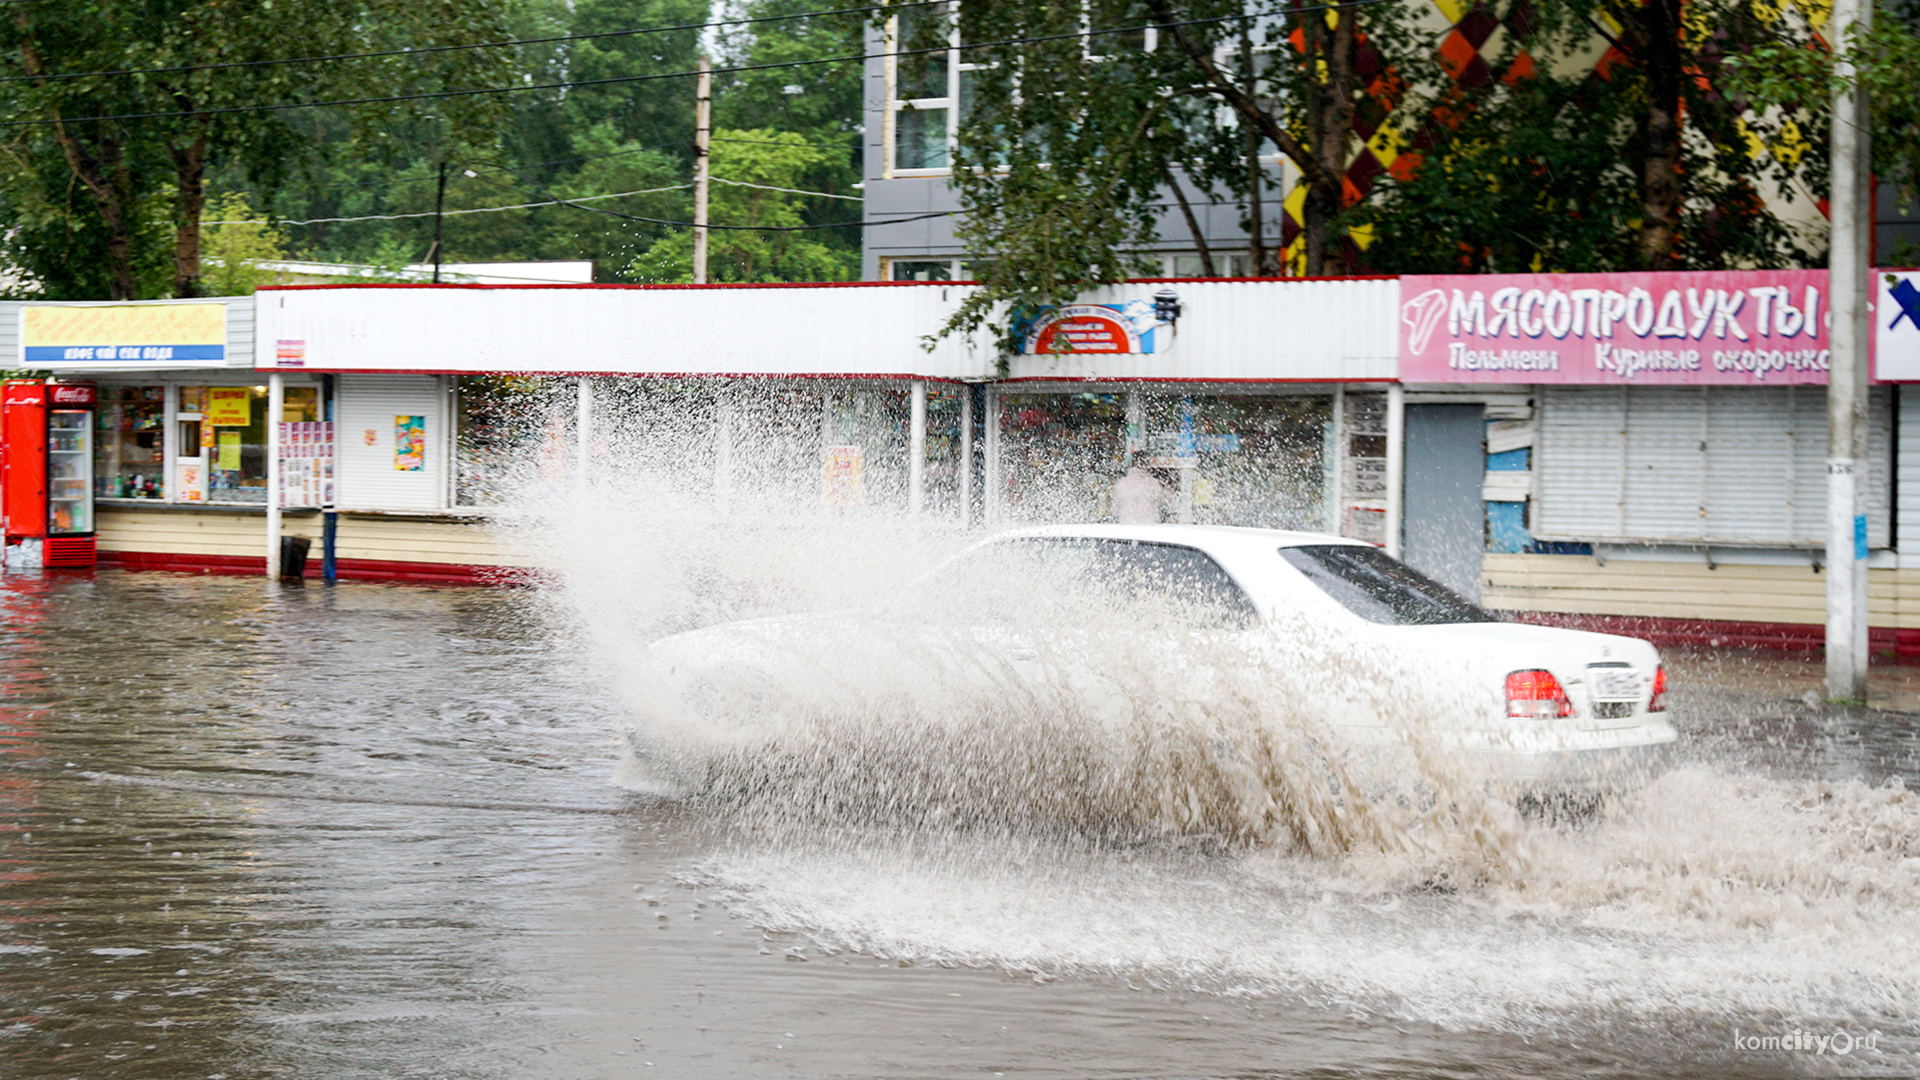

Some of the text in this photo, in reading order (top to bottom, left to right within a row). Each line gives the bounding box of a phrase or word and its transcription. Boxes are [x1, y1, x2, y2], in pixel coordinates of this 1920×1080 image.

[1448, 285, 1820, 342] МЯСОПРОДУКТЫ
[1449, 342, 1559, 371] Пельмени
[1595, 342, 1701, 379] Куриные
